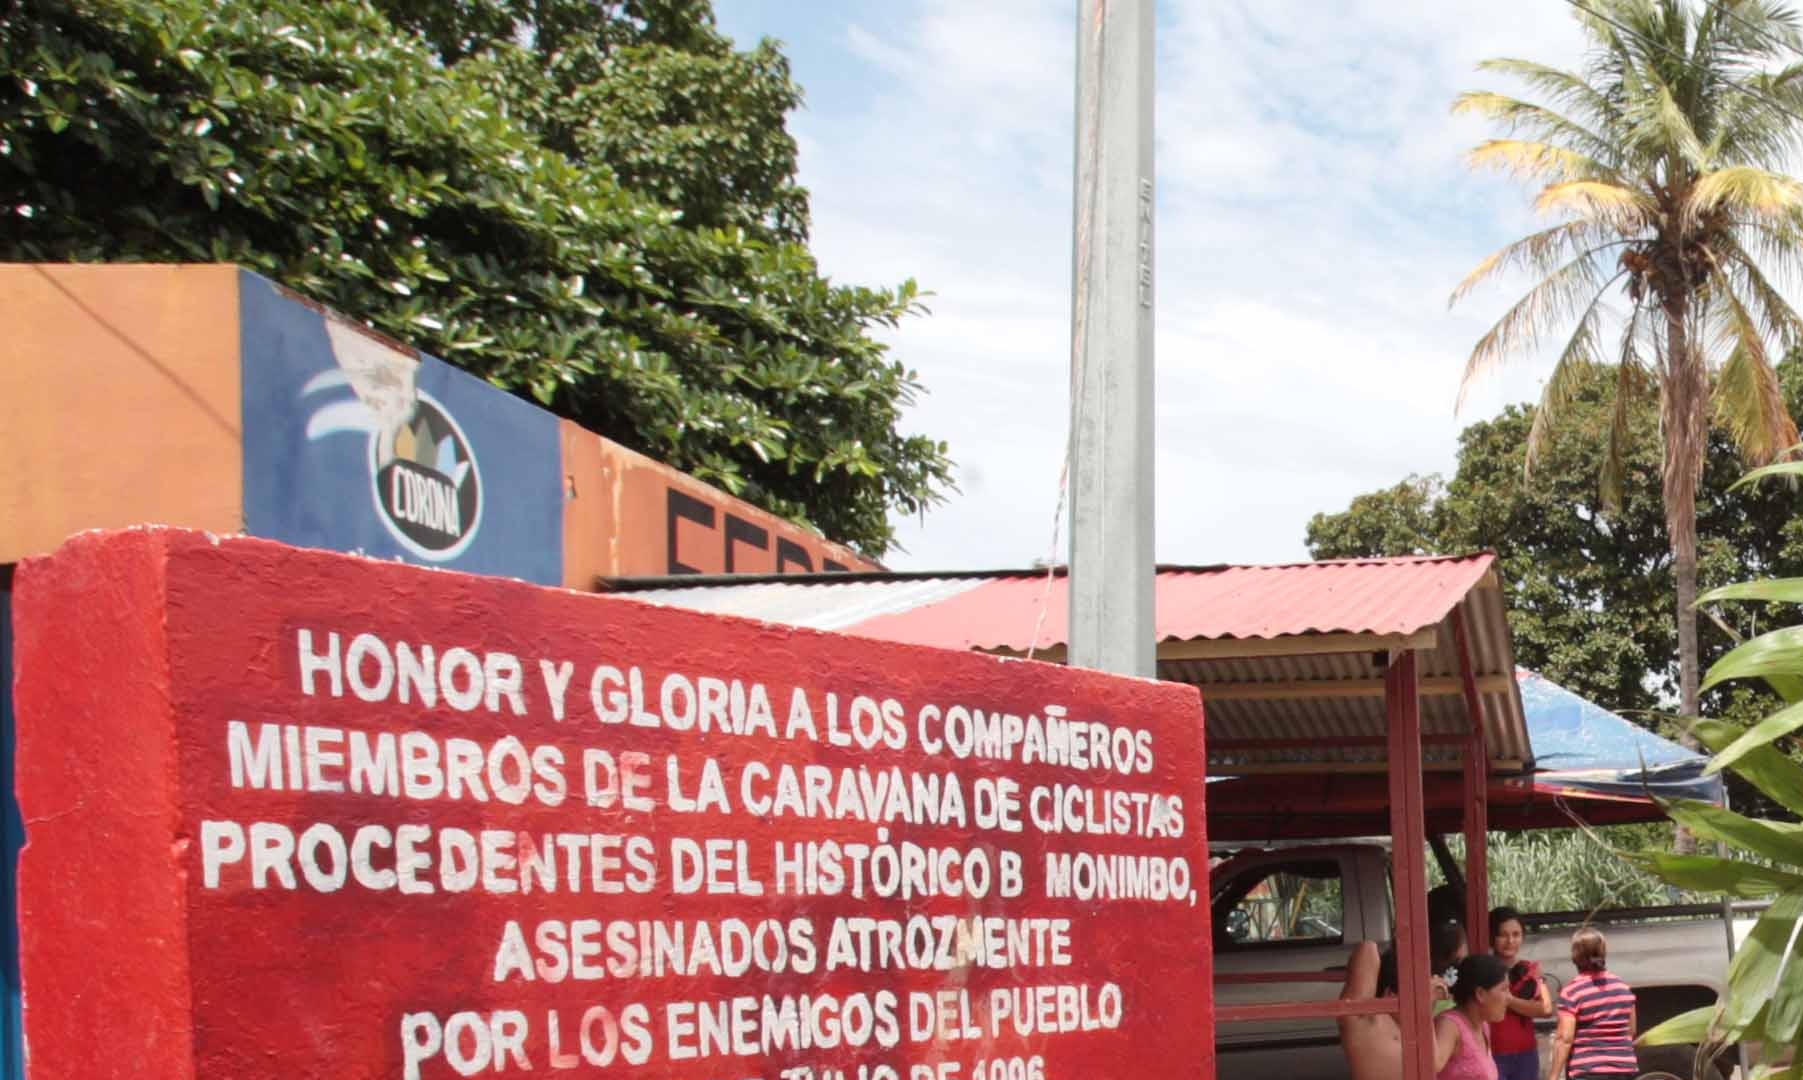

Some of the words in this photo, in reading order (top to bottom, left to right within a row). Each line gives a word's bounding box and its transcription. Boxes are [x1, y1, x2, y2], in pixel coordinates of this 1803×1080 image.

[393, 464, 461, 538] CORONA
[298, 628, 528, 716] HONOR
[539, 659, 574, 722] Y
[590, 664, 777, 739] GLORIA
[785, 686, 819, 742] A
[825, 692, 908, 751] LOS
[917, 704, 1154, 775] COMPAÑEROS
[227, 720, 568, 807] MIEMBROS
[583, 748, 656, 813] DE
[666, 754, 732, 817] LA
[740, 760, 967, 830] CARAVANA
[973, 777, 1024, 834] DE
[1029, 783, 1185, 840] CICLISTAS
[200, 819, 659, 895] PROCEDENTES
[671, 837, 764, 896] DEL
[774, 827, 991, 901] HISTÓRICO
[999, 849, 1024, 899] B
[493, 918, 817, 984] ASESINADOS
[825, 913, 1072, 973] ATROZMENTE
[547, 1002, 653, 1069] LOS
[665, 989, 901, 1060] ENEMIGOS
[909, 988, 983, 1043] DEL
[989, 982, 1123, 1039] PUEBLO
